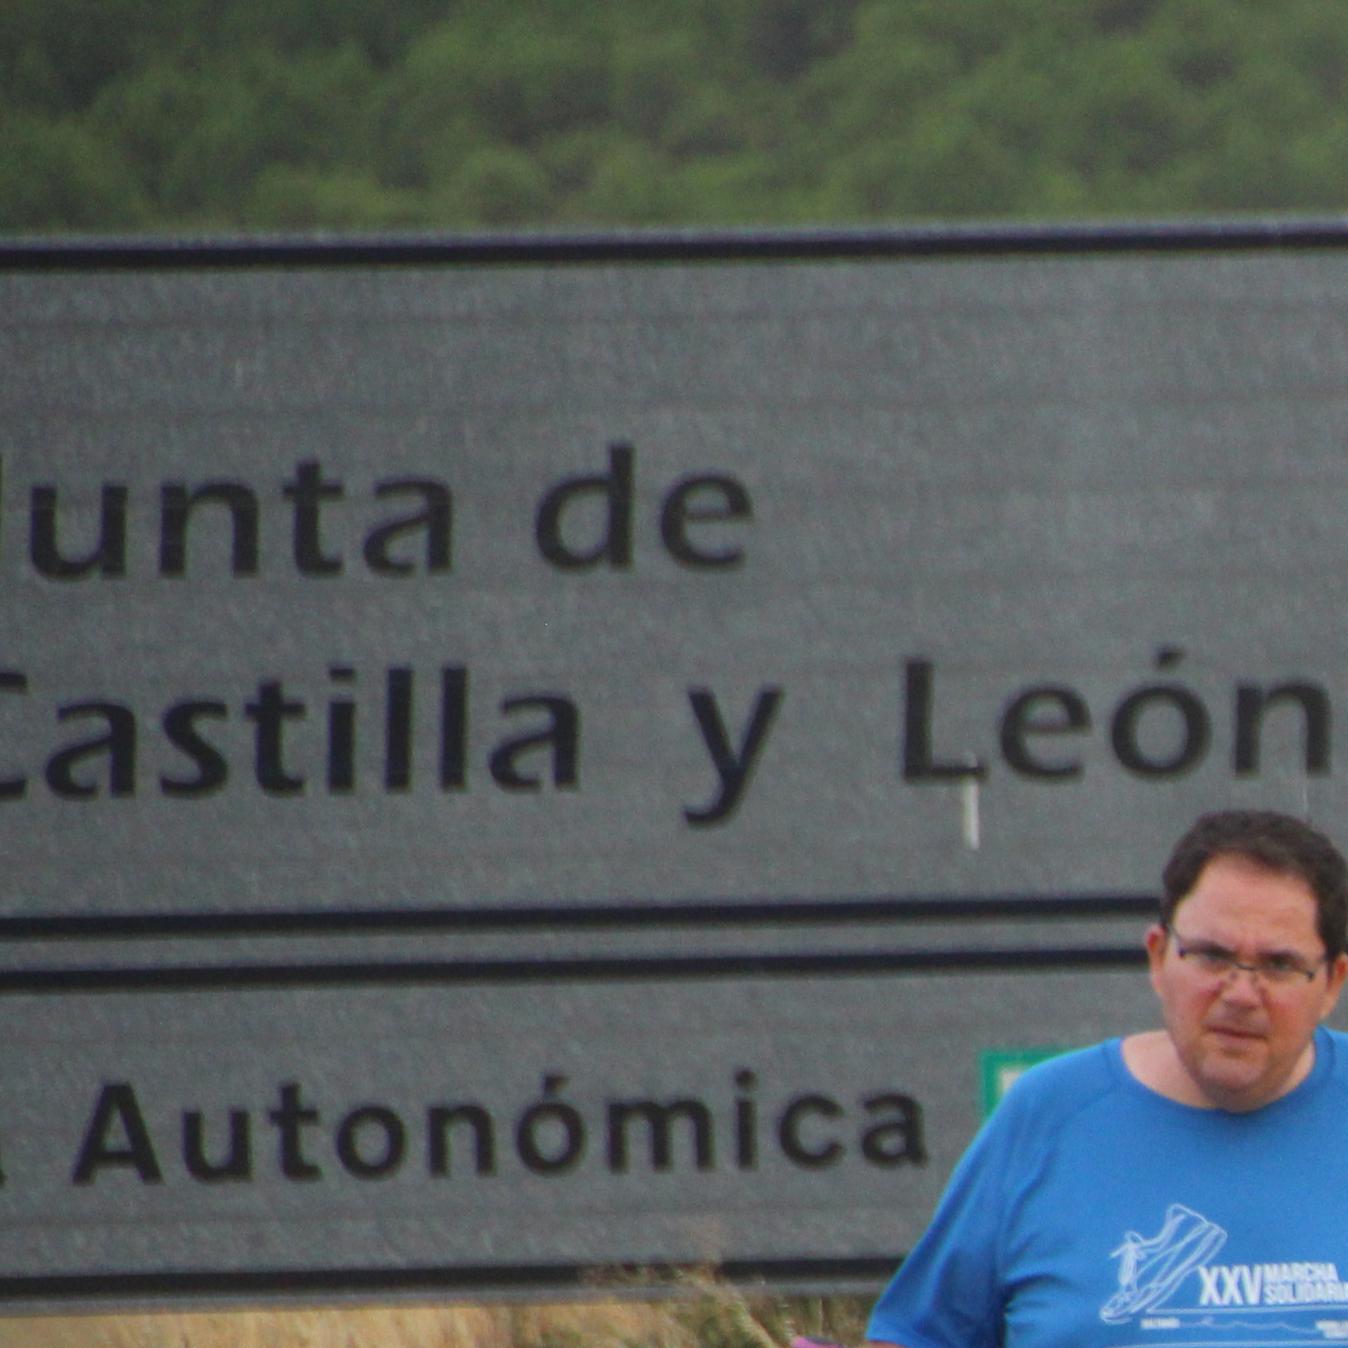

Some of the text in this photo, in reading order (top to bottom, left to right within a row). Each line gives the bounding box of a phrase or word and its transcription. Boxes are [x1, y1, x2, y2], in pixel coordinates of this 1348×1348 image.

[0, 441, 756, 581] unta de
[682, 685, 785, 829] y
[903, 642, 1333, 785] León
[72, 1069, 930, 1188] Autonómica
[1199, 1264, 1263, 1306] XXV
